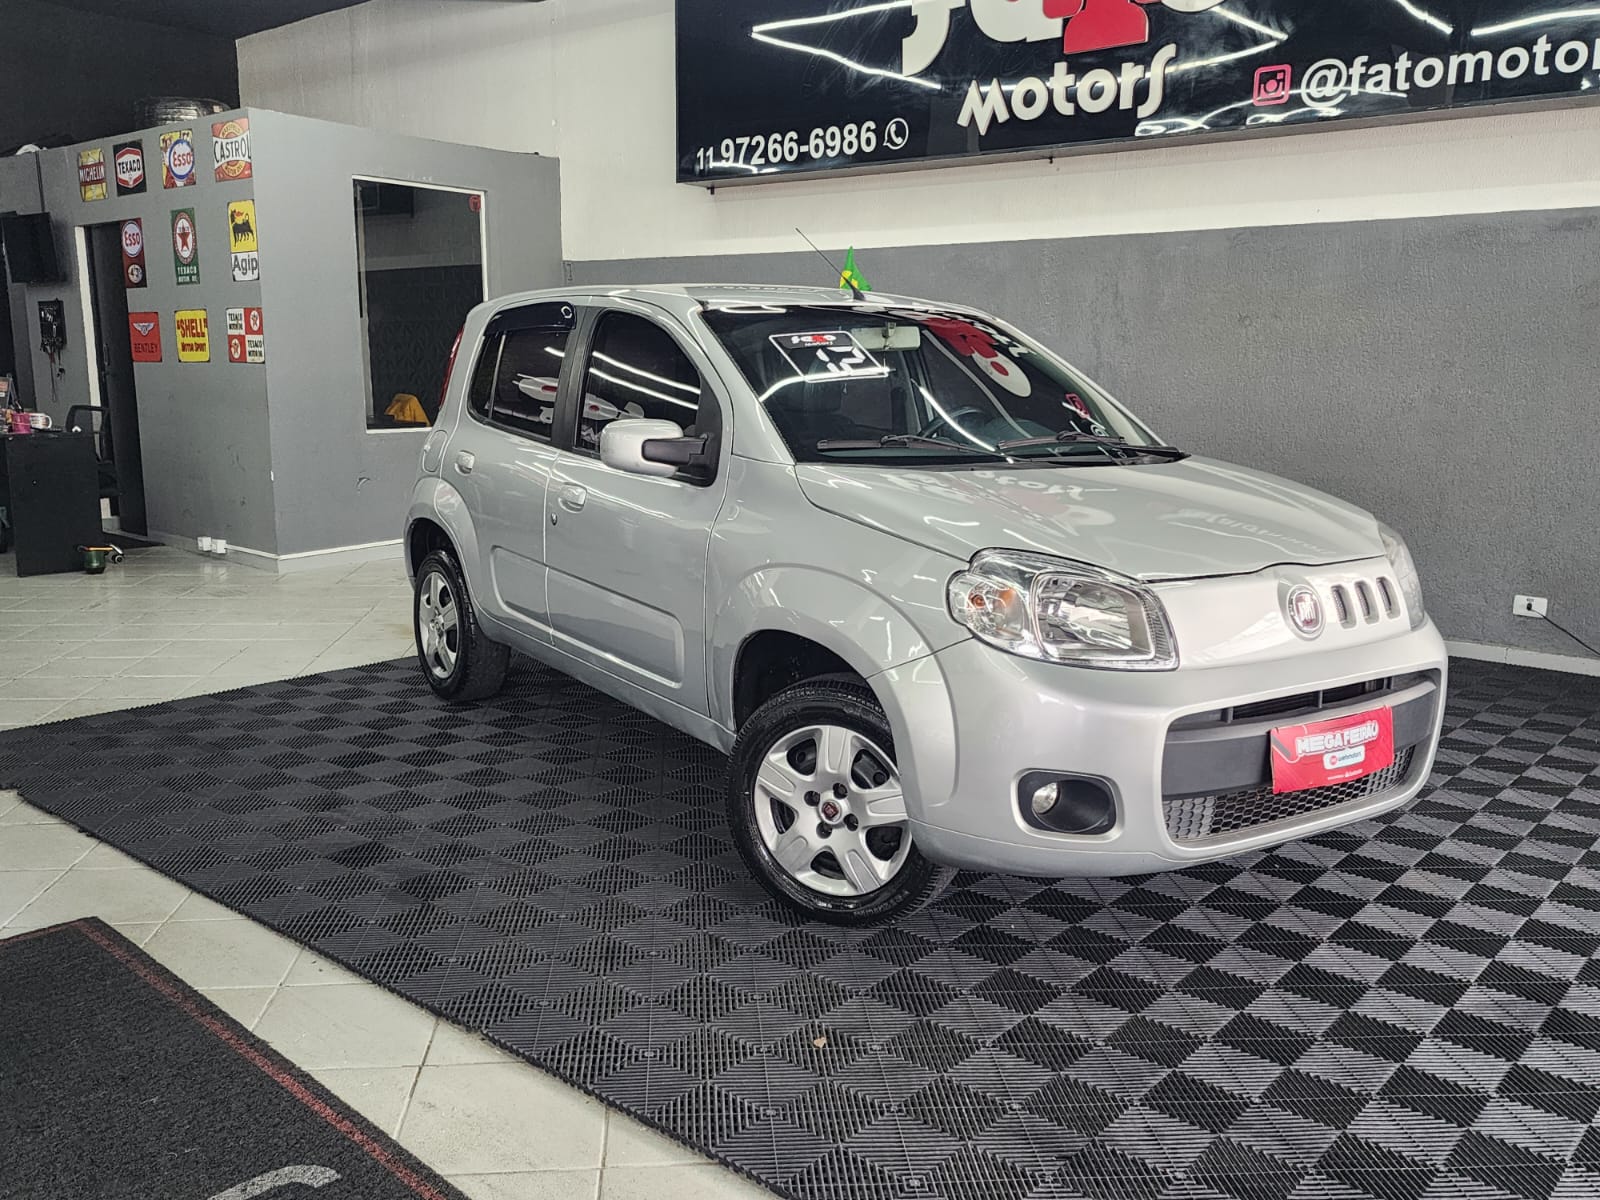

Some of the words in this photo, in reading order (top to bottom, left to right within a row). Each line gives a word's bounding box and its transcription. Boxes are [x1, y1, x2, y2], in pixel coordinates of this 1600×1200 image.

[957, 43, 1177, 135] Motors
[213, 133, 251, 163] CASTROL
[720, 121, 877, 166] 97266-6986
[118, 158, 141, 175] TEXACO
[231, 254, 258, 276] Agip
[1295, 731, 1343, 755] MEGA
